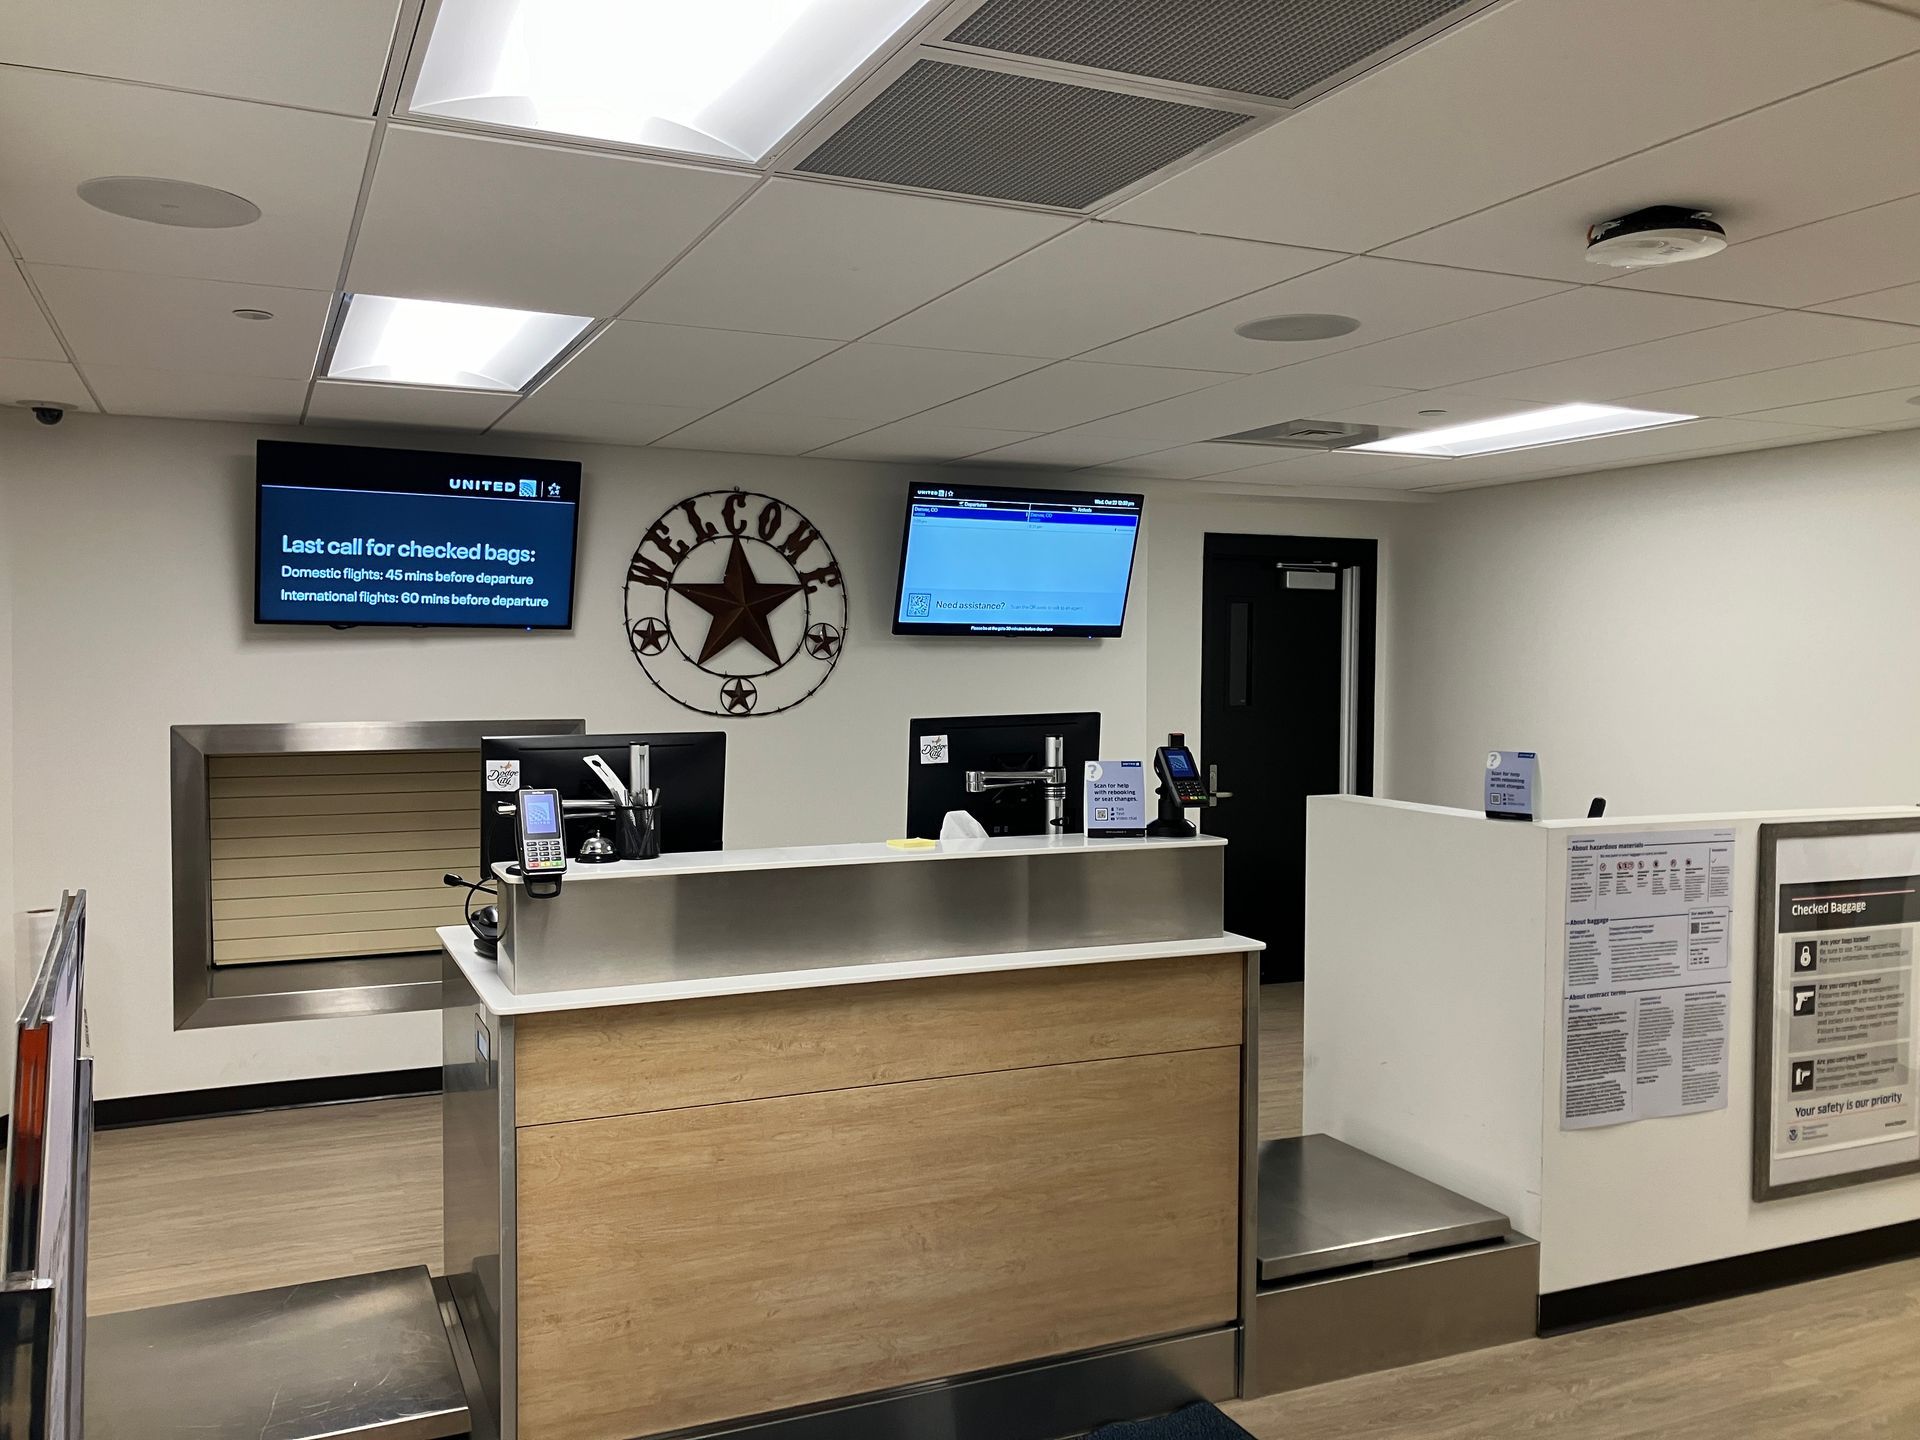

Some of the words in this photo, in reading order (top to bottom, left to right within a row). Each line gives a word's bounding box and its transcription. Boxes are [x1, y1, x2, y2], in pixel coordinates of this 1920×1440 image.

[449, 479, 516, 492] UNITED
[282, 534, 325, 554] Last
[327, 537, 363, 555] call
[365, 538, 395, 557] for
[397, 540, 482, 560] checked
[484, 543, 536, 566] bags:
[629, 493, 841, 595] WELCOME
[281, 565, 342, 579] Domestic
[343, 567, 384, 582] flights:
[385, 569, 404, 581] 45
[405, 570, 435, 582] mins
[435, 571, 475, 583] before
[475, 572, 534, 586] departure
[280, 588, 358, 602] International
[359, 590, 399, 605] flights:
[401, 592, 420, 604] 60
[421, 593, 450, 604] mins
[451, 594, 491, 605] before
[491, 594, 550, 608] departure
[936, 600, 959, 609] Need
[959, 601, 1006, 610] assistance?
[1589, 842, 1618, 850] hazardous
[1619, 841, 1644, 849] materials
[1792, 903, 1829, 916] Checked
[1831, 901, 1867, 914] Baggage
[1586, 917, 1609, 926] baggage
[1830, 939, 1841, 947] your
[1829, 983, 1838, 991] you
[1586, 992, 1609, 1000] contract
[1795, 1106, 1815, 1118] Your
[1817, 1102, 1844, 1115] safety
[1846, 1099, 1853, 1110] is
[1855, 1097, 1869, 1108] our
[1871, 1093, 1903, 1108] priority
